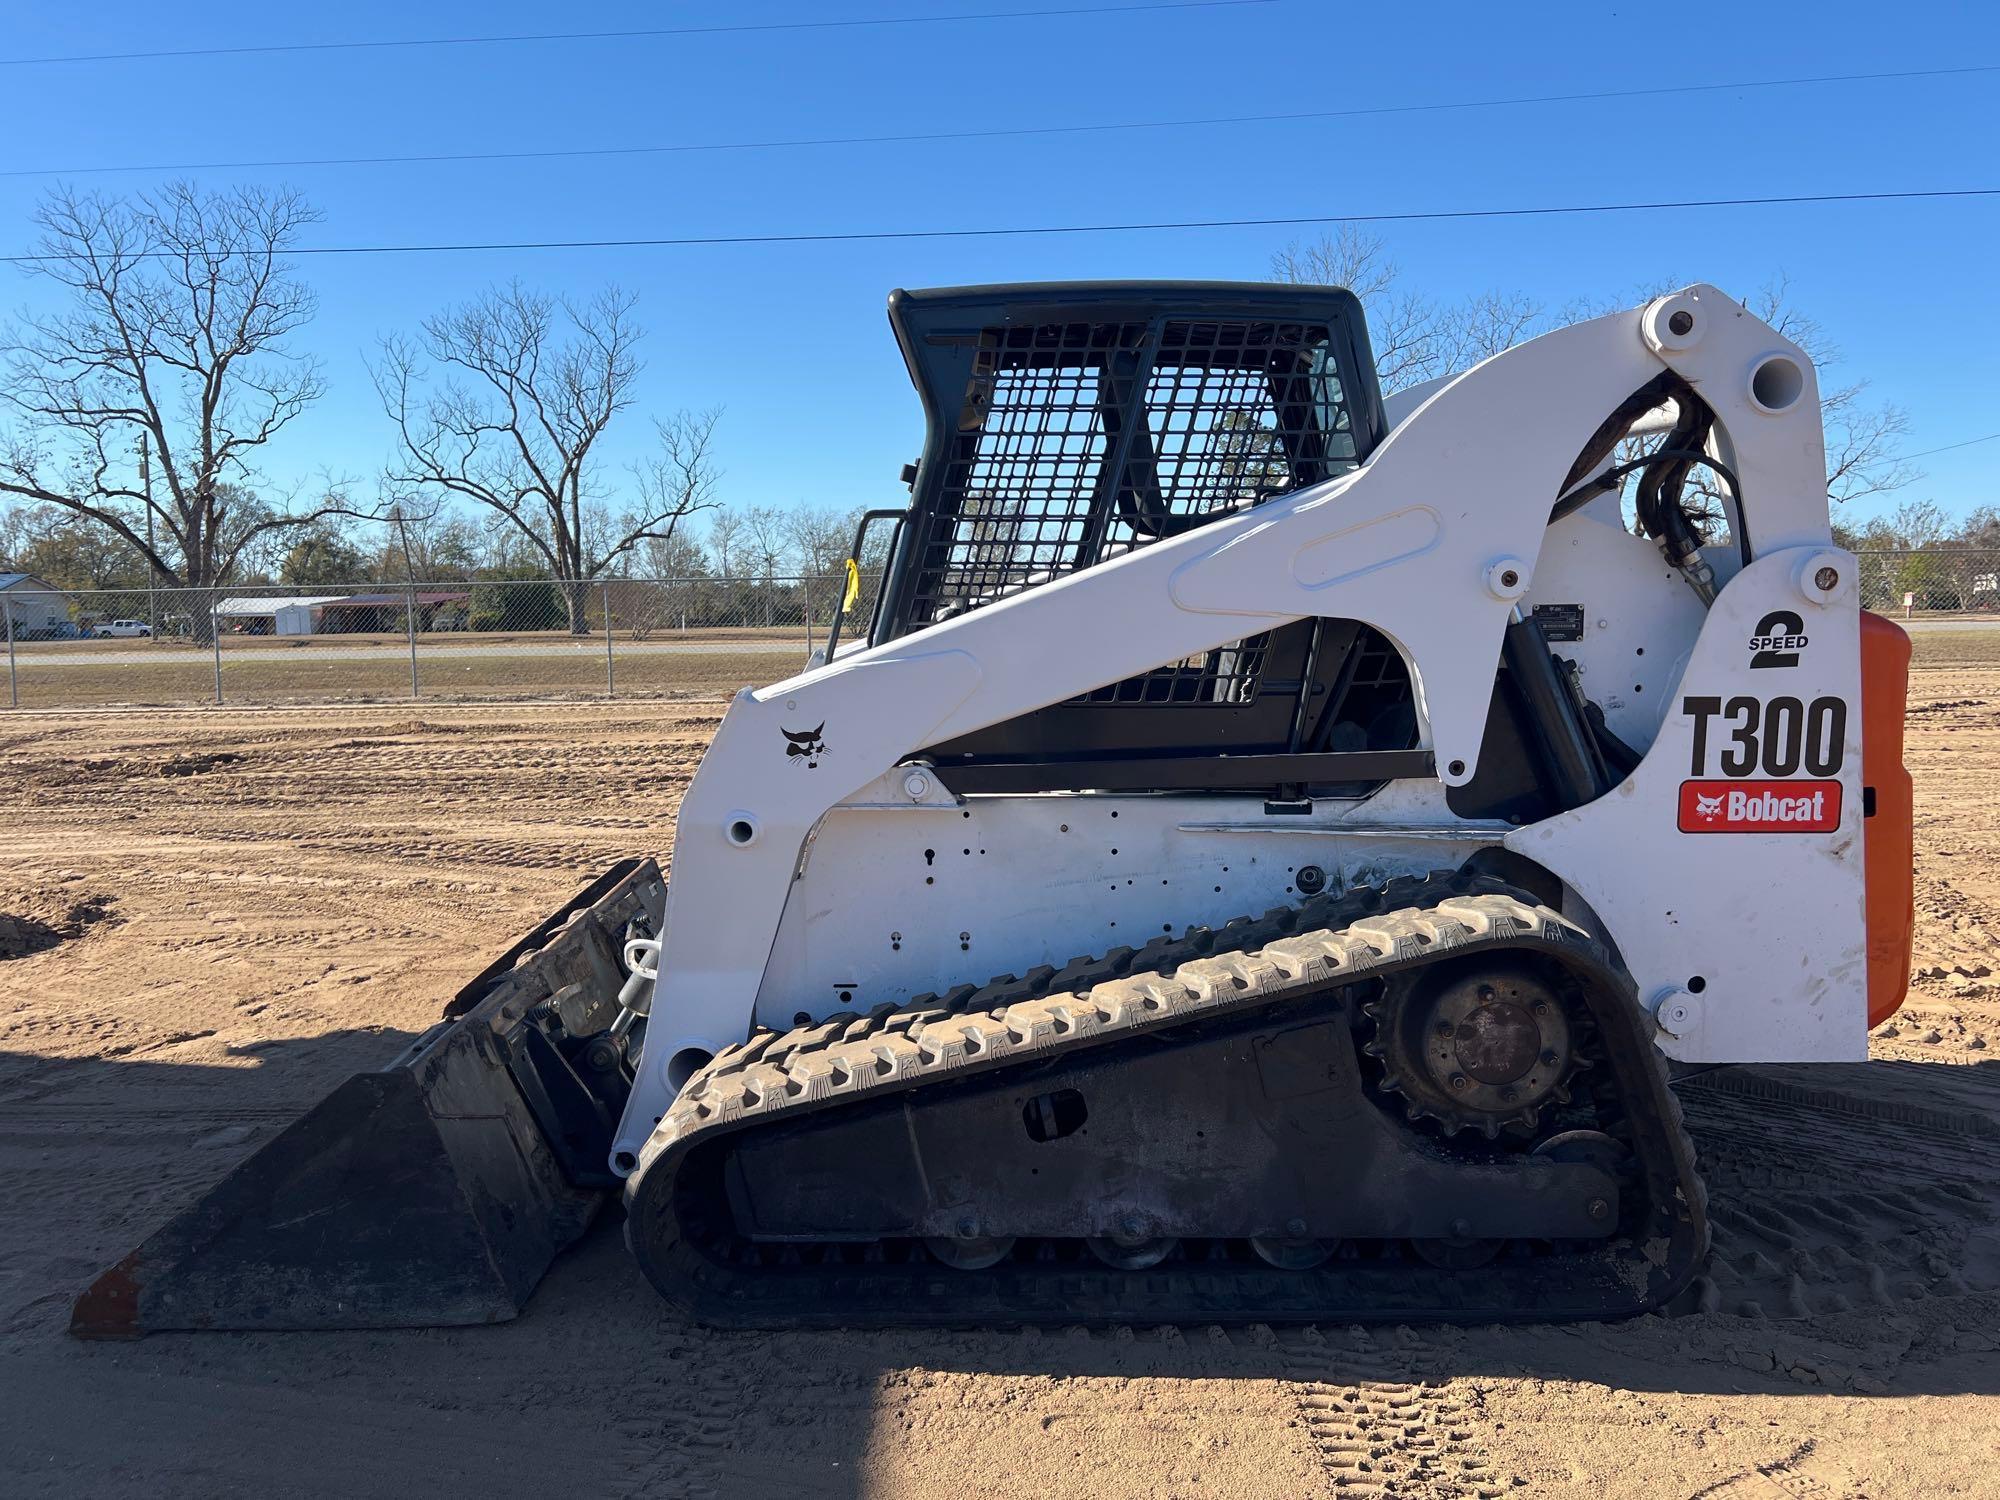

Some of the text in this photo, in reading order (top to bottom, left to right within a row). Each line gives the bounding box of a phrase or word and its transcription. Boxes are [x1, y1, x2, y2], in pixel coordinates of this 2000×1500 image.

[1748, 635, 1809, 651] SPEED
[1749, 610, 1804, 669] 2
[1683, 696, 1847, 777] T300
[1727, 791, 1824, 822] Bobcat
